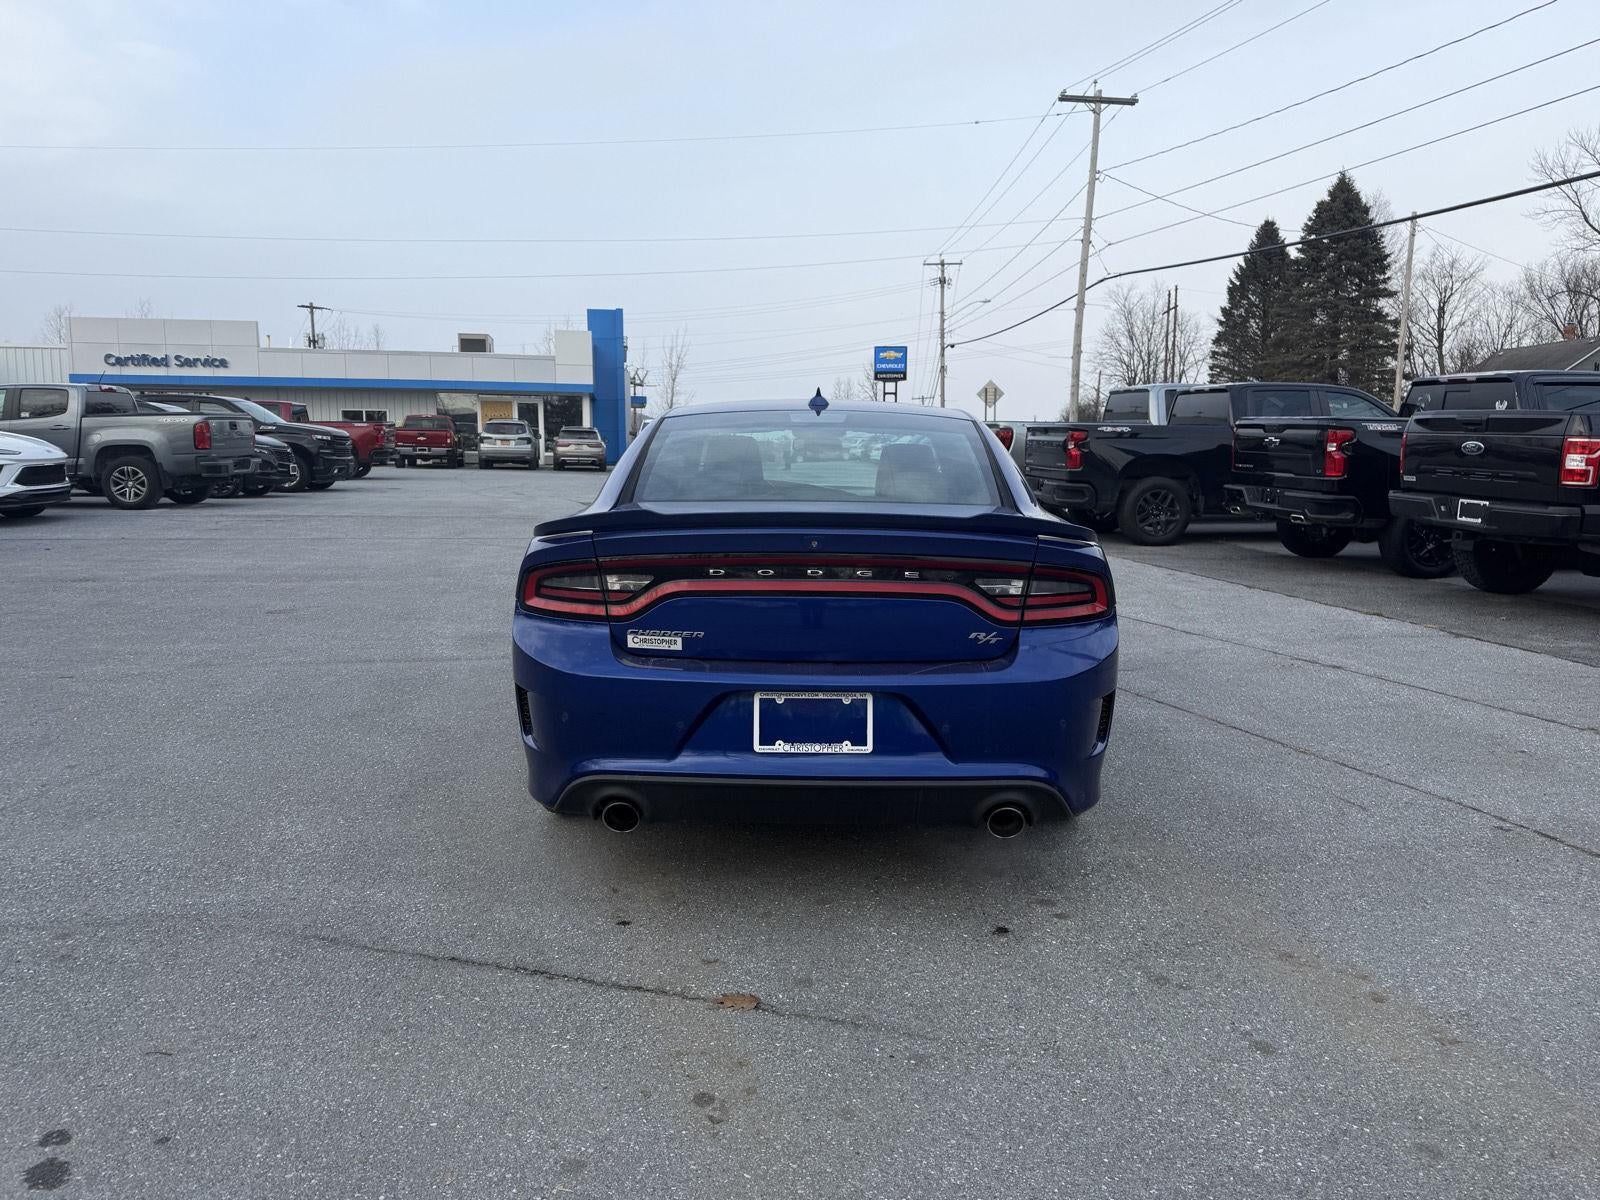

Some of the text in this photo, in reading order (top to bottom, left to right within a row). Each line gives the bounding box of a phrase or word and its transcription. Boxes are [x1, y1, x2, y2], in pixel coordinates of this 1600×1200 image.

[103, 353, 230, 369] Certified Service
[709, 568, 920, 579] DODGE
[627, 629, 705, 638] CHARGER
[968, 631, 1003, 644] R/T
[631, 635, 678, 646] CHRISTOPHER
[782, 742, 844, 753] CHRISTOPHER
